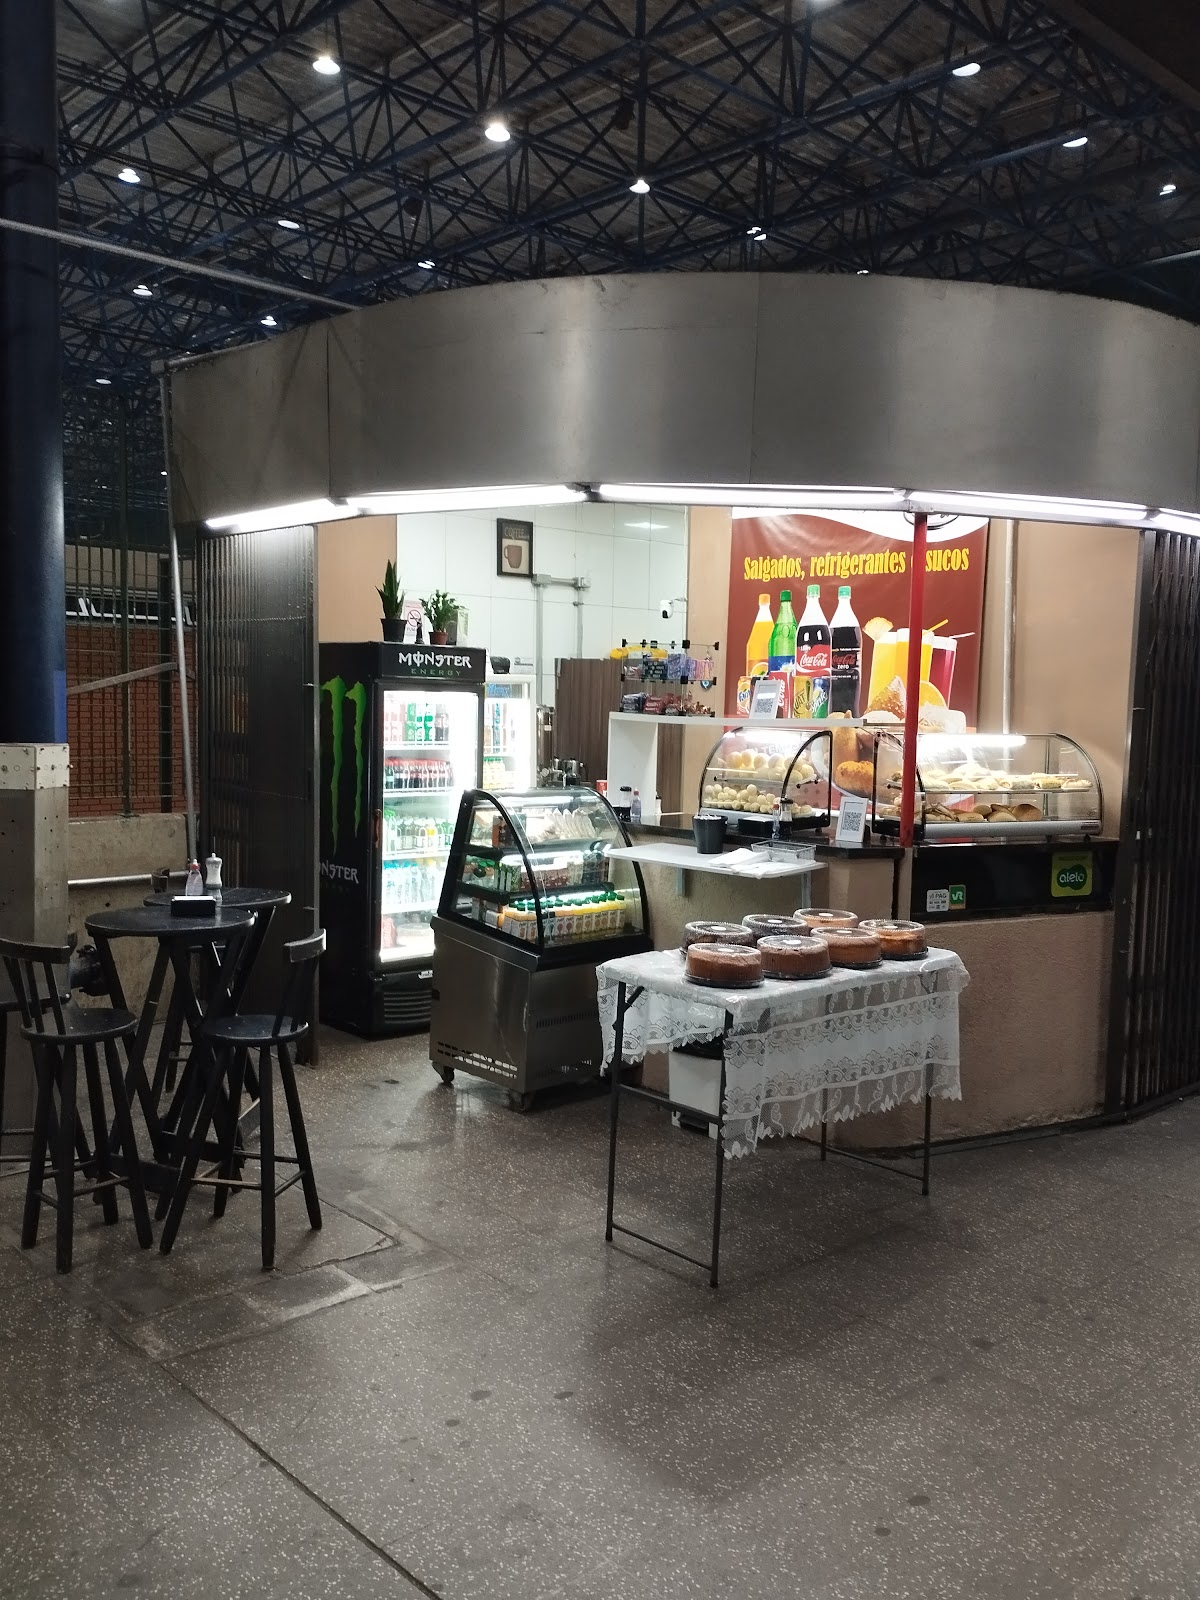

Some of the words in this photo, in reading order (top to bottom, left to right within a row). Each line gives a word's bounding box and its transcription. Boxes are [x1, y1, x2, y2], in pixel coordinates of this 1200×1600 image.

[744, 555, 805, 583] Salgados,
[810, 549, 906, 579] refrigerantes
[925, 547, 970, 573] sucos
[398, 651, 472, 668] MONSTER
[411, 668, 461, 676] ENERGY
[321, 860, 360, 884] NSTER
